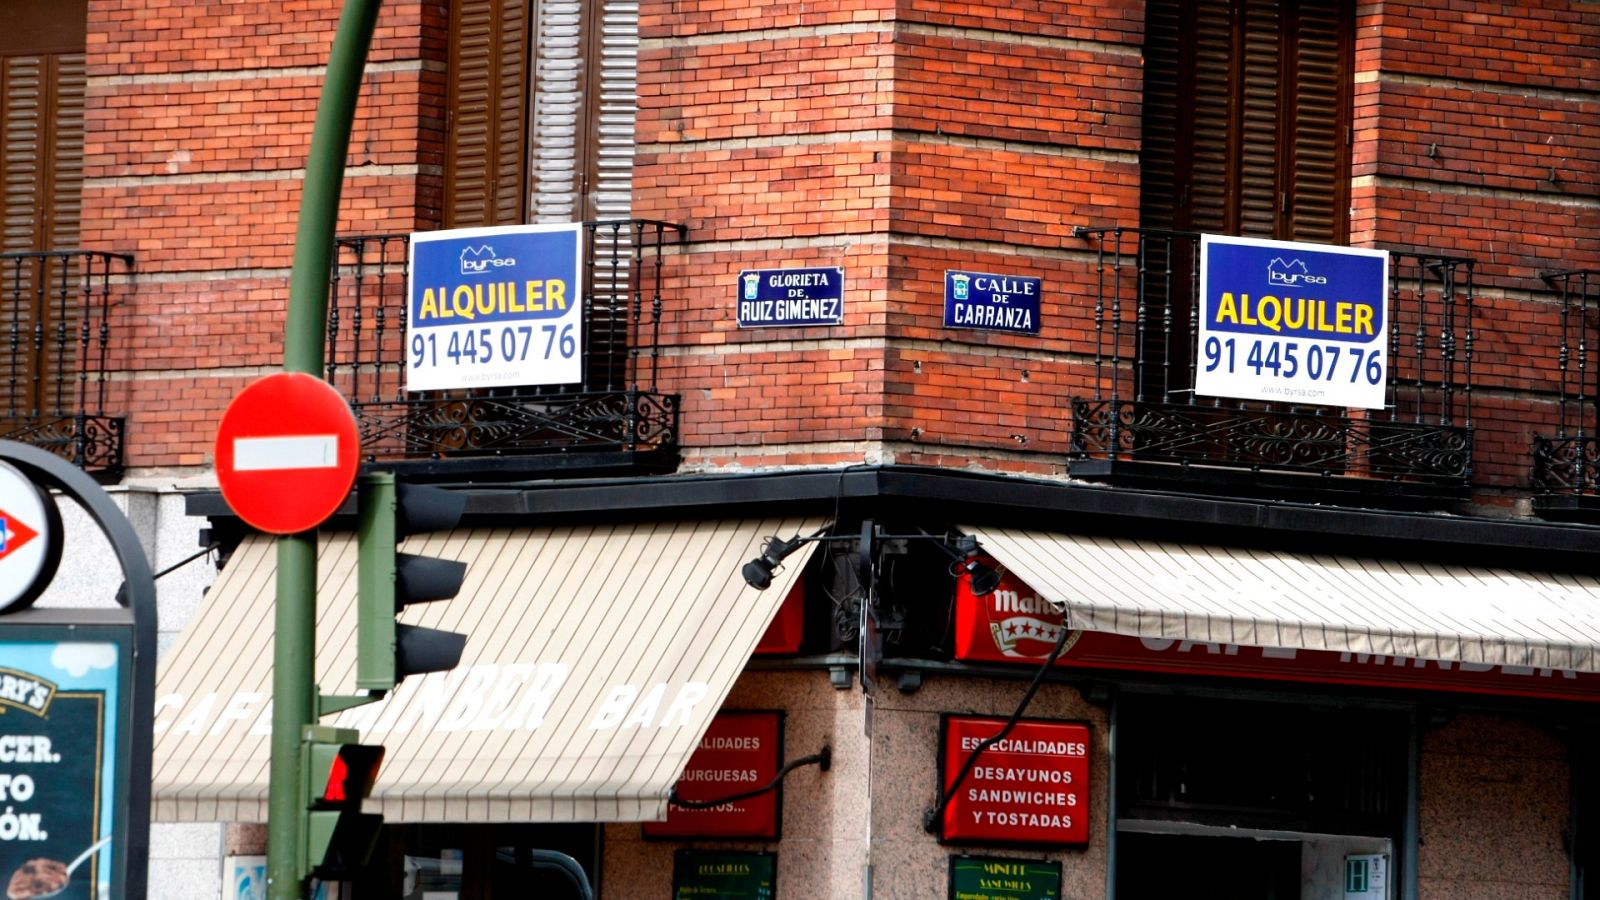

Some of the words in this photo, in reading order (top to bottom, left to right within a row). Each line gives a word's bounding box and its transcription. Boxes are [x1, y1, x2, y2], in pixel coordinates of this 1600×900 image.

[463, 258, 516, 271] byrsa
[769, 273, 829, 287] GLORIETA
[974, 278, 1034, 295] CALLE
[1271, 270, 1327, 284] byrsa
[419, 279, 566, 320] ALQUILER
[788, 289, 804, 298] DE
[992, 294, 1009, 303] DE
[741, 301, 773, 321] RUIZ
[775, 295, 838, 320] GIMÉNEZ
[954, 303, 1031, 329] CARRANZA
[1215, 292, 1374, 335] ALQUILER
[412, 333, 437, 369] 91
[447, 328, 493, 366] 445
[501, 326, 533, 362] 07
[541, 323, 576, 360] 76
[1205, 336, 1235, 373] 91
[1247, 340, 1298, 379] 445
[1306, 344, 1341, 381] 07
[1349, 348, 1382, 385] 76
[994, 589, 1060, 615] Mah
[588, 681, 709, 729] BAR
[974, 766, 1072, 783] DESAYUNOS
[968, 788, 1077, 807] SANDWICHES
[973, 811, 982, 824] Y
[987, 812, 1072, 828] TOSTADAS
